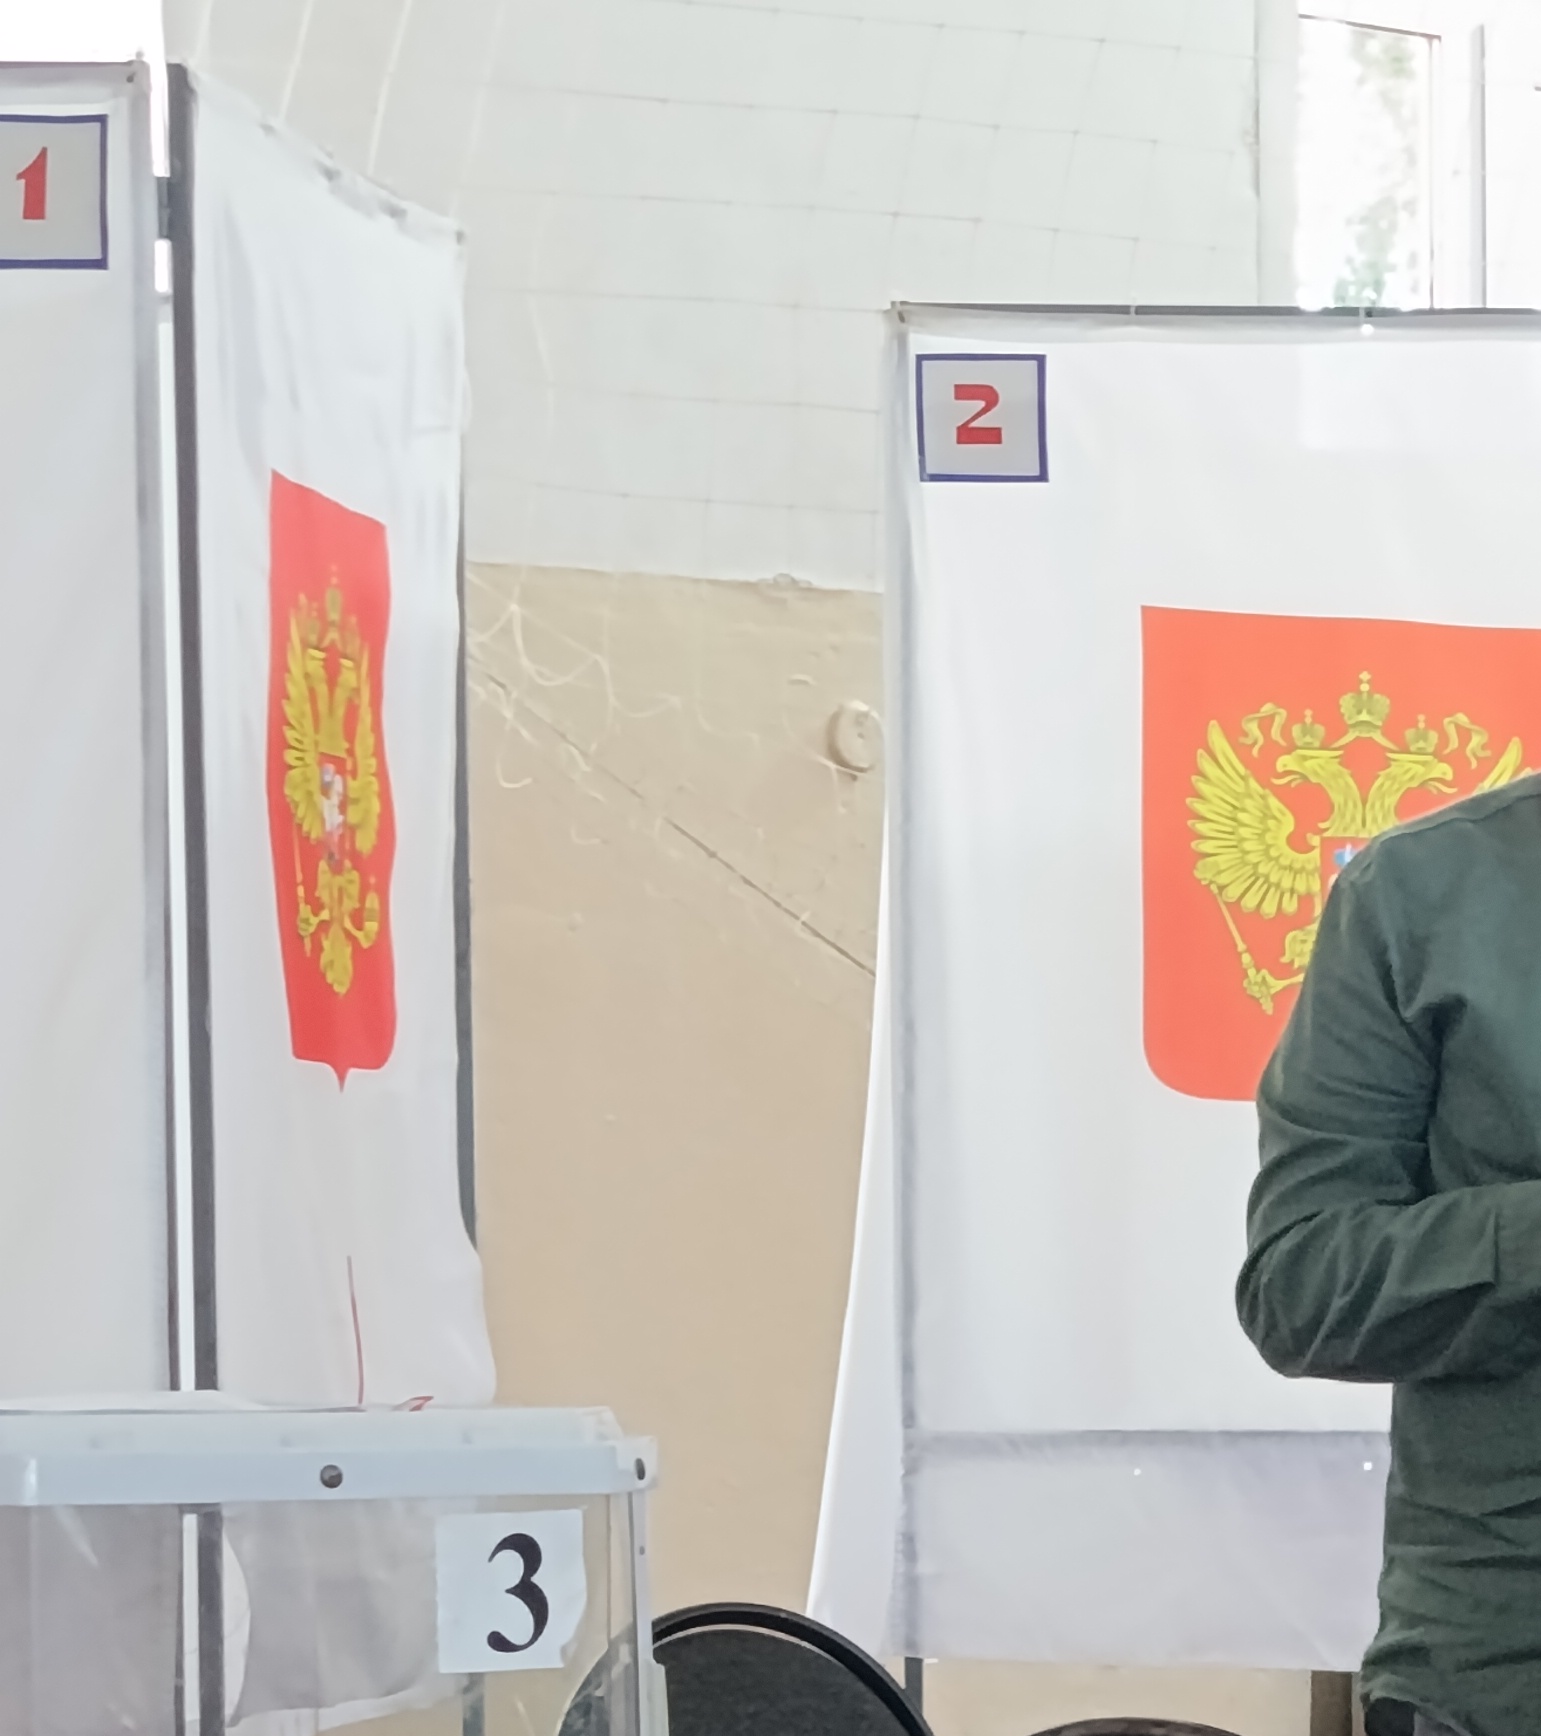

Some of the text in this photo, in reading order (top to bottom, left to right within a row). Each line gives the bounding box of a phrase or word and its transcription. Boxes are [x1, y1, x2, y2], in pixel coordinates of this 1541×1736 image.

[16, 146, 48, 220] 1
[953, 383, 1003, 445] 2
[486, 1532, 550, 1653] 3
